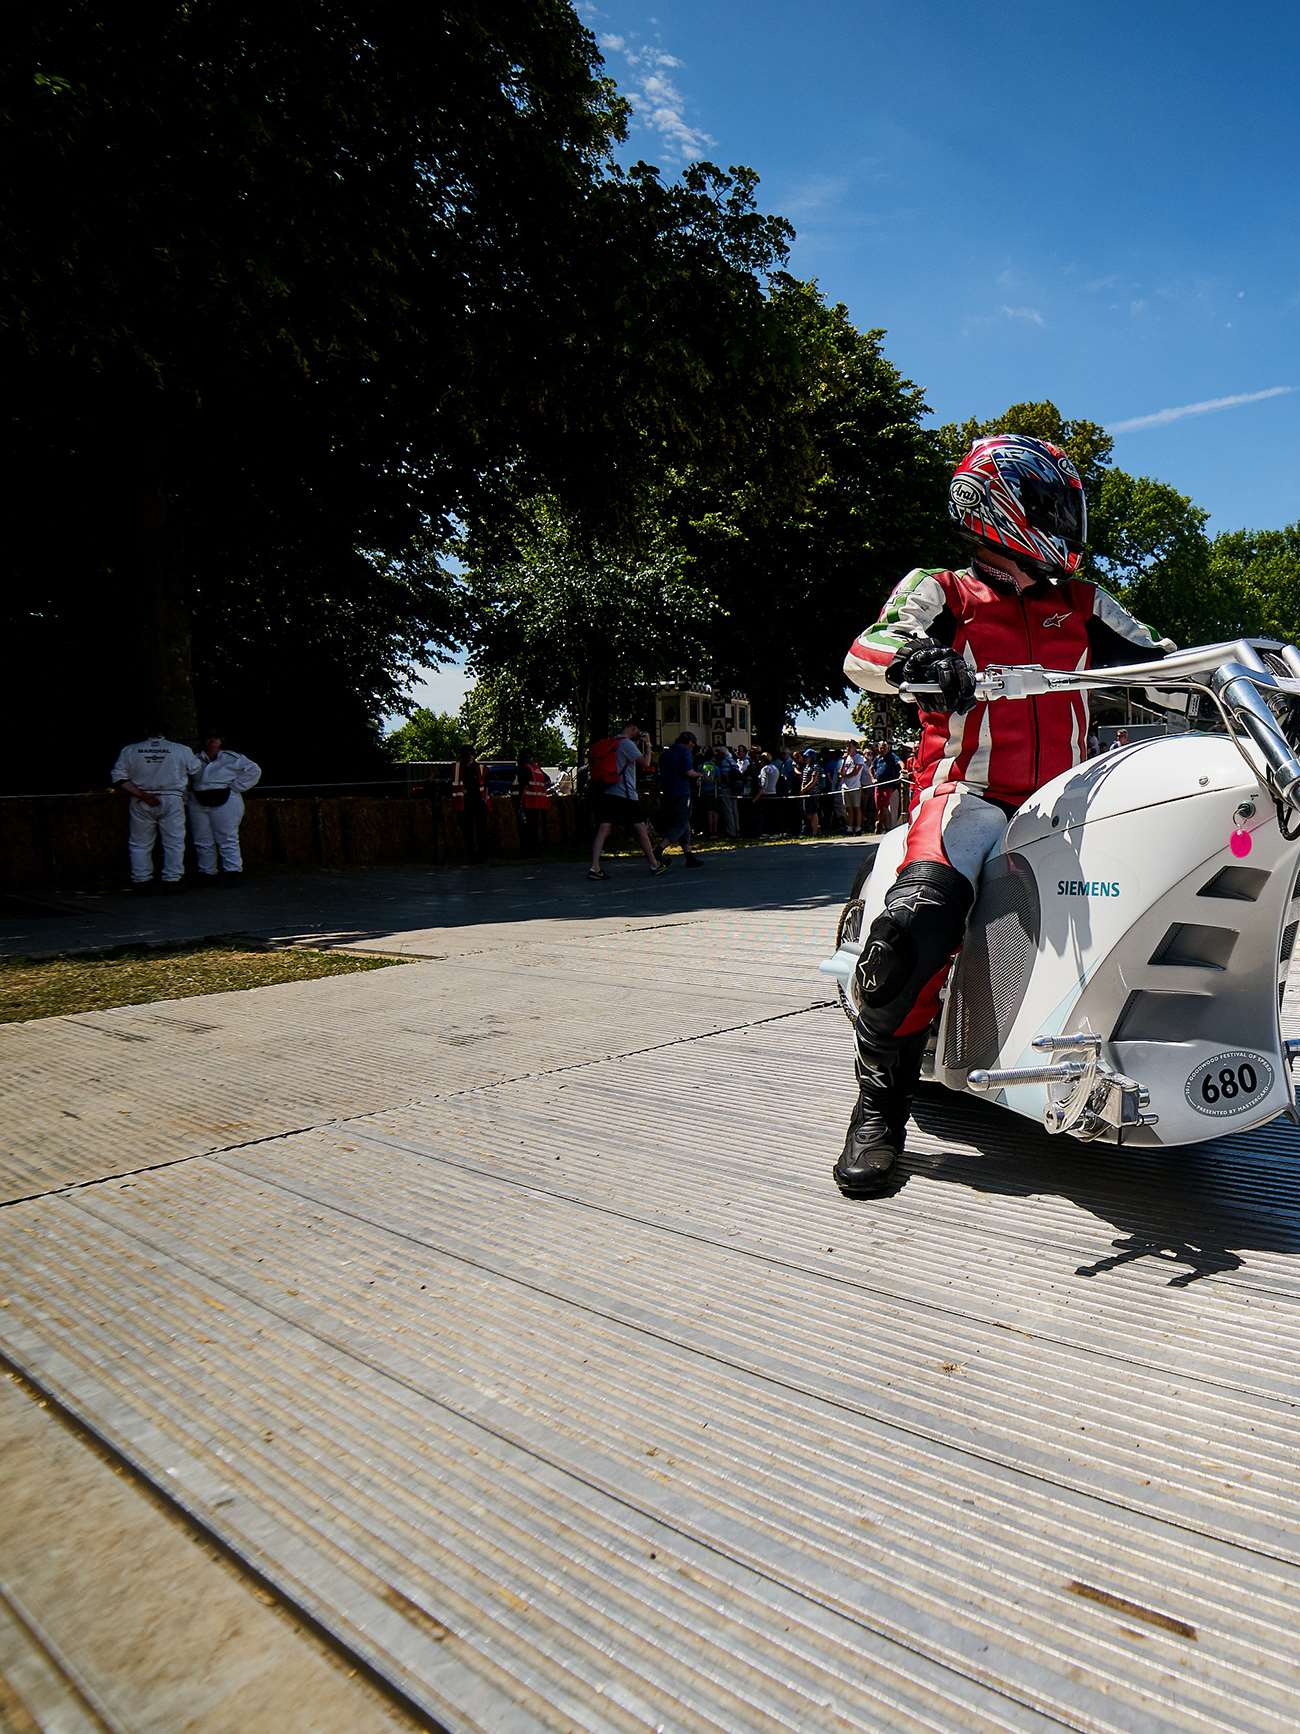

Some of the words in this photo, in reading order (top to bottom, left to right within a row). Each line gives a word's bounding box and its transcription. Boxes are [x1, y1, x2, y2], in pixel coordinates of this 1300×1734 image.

[952, 484, 976, 502] Arai
[1057, 880, 1120, 897] SIEMENS
[1189, 1056, 1219, 1081] GOODWOOD
[1220, 1052, 1247, 1060] FESTIVAL
[1257, 1055, 1272, 1072] SPEED
[1202, 1063, 1257, 1104] 680
[1195, 1105, 1228, 1116] PRESENTED
[1237, 1086, 1270, 1112] MASTERCARD
